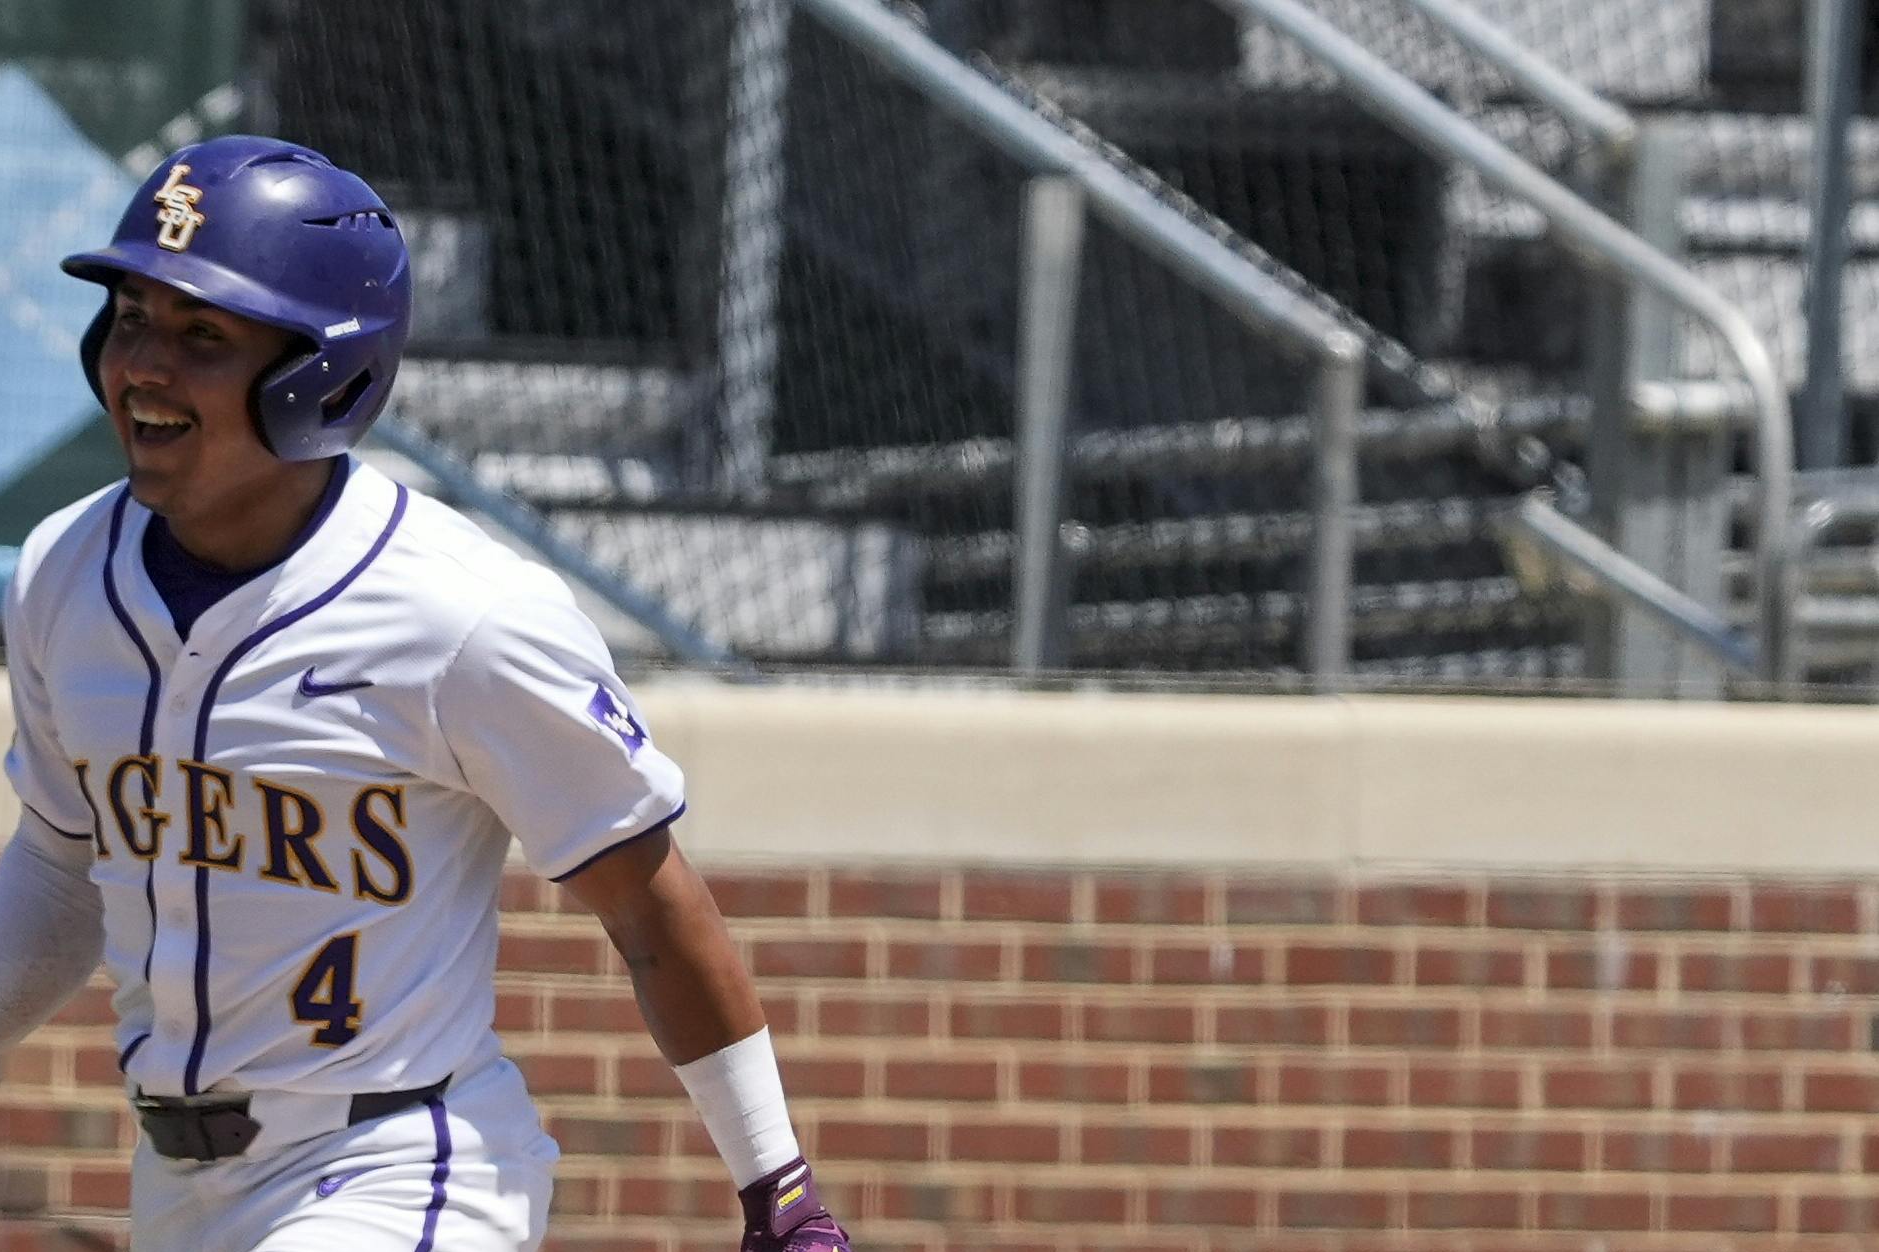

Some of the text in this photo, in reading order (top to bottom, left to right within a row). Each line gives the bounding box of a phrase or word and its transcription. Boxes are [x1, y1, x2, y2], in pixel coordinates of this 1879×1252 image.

[153, 164, 206, 254] LSU
[73, 753, 415, 907] IGERS
[290, 930, 365, 1048] 4
